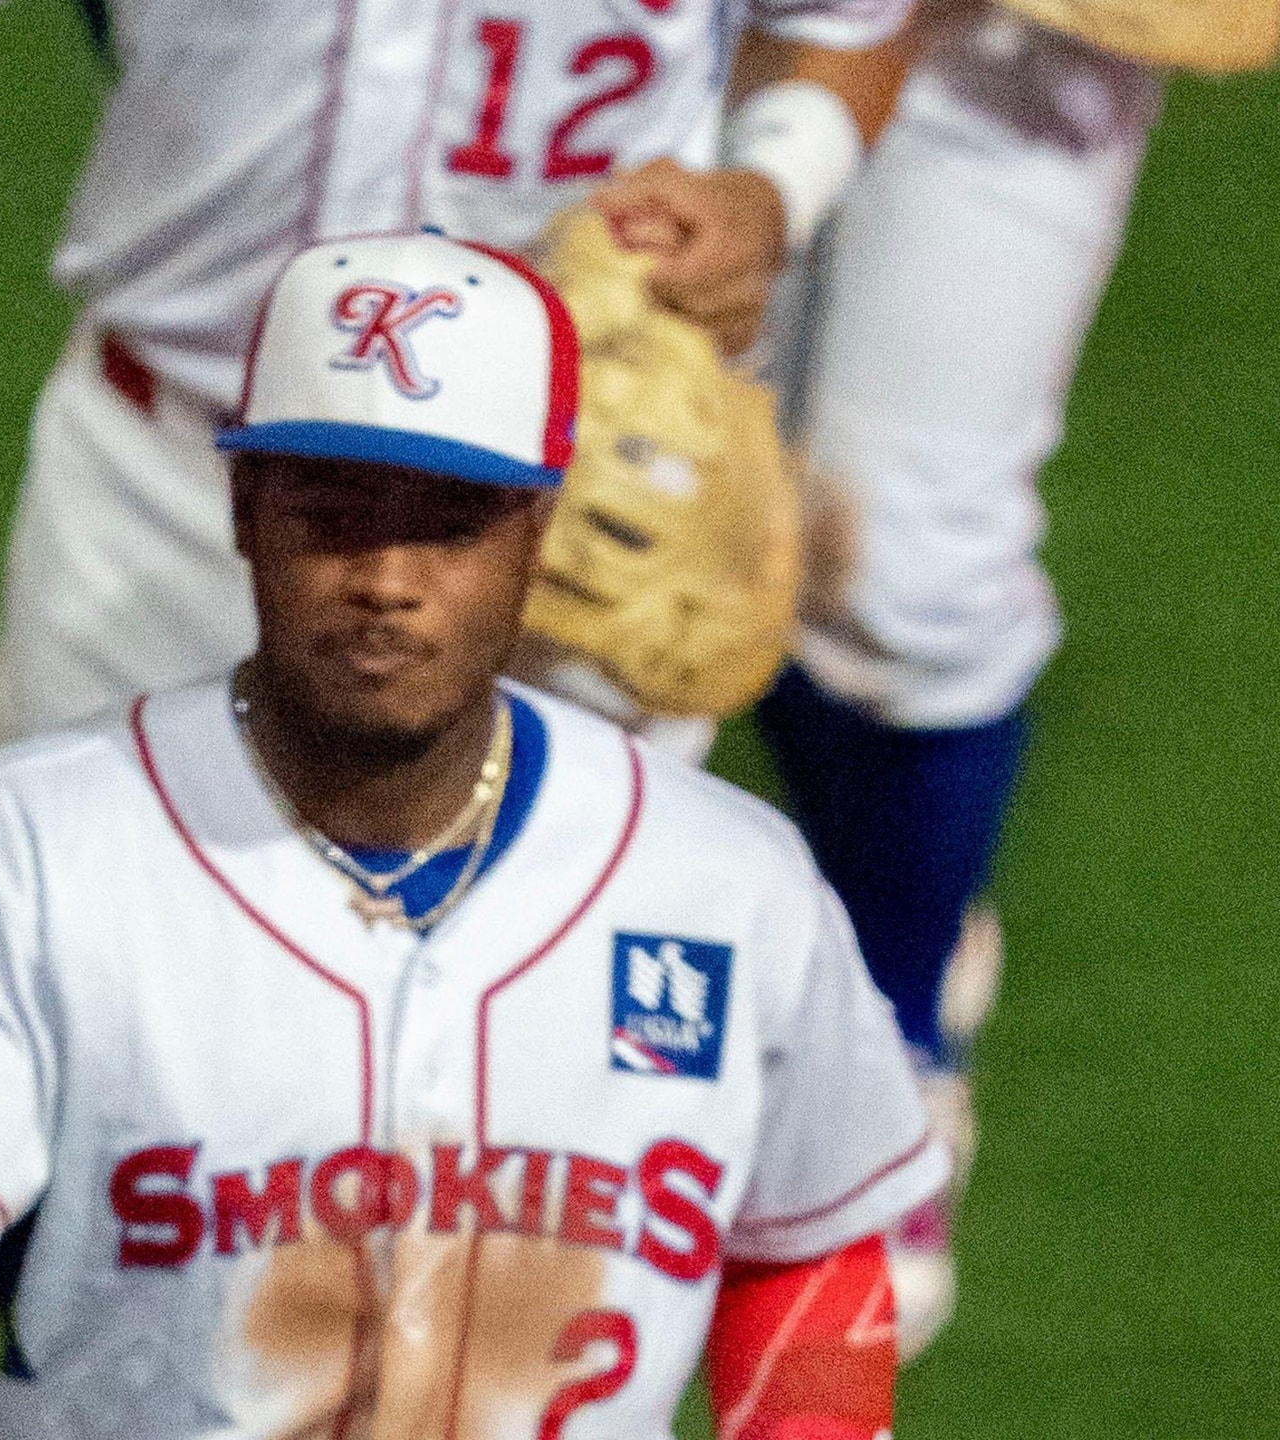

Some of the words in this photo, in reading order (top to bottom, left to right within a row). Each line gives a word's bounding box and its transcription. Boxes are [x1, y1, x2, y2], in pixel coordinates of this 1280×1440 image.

[447, 18, 658, 182] 12
[330, 278, 463, 401] K
[109, 1139, 723, 1284] SMOKIES
